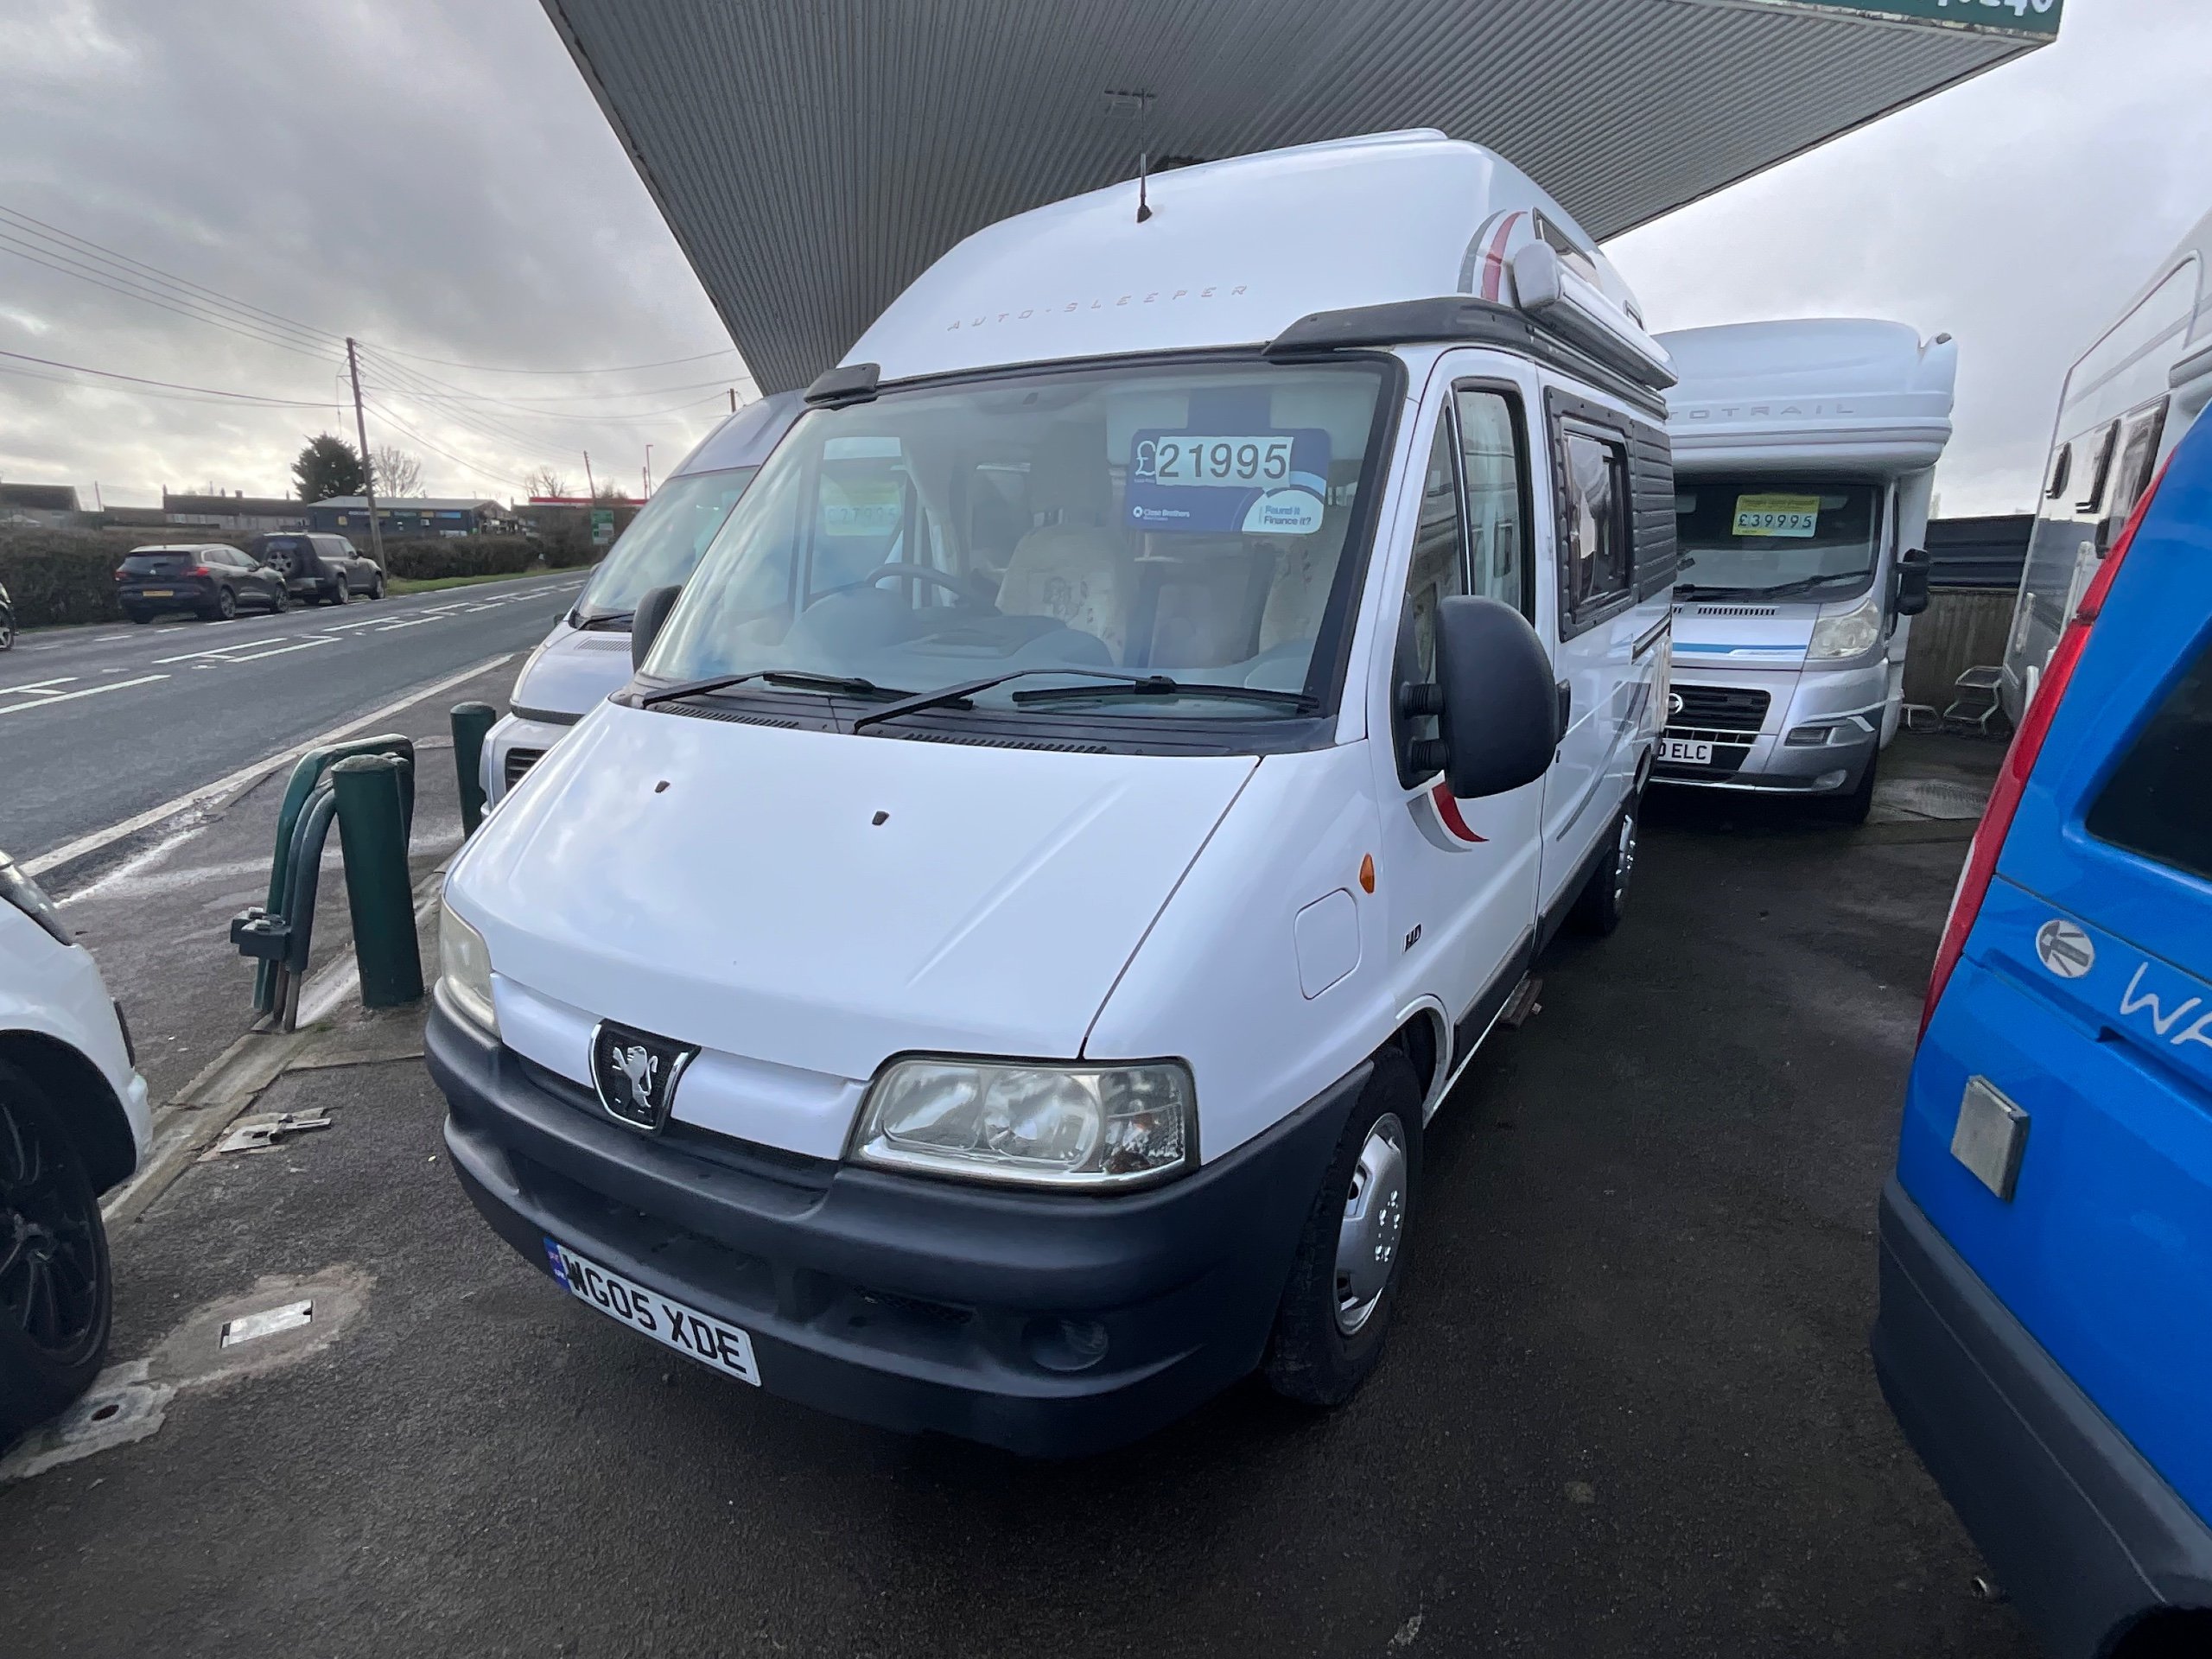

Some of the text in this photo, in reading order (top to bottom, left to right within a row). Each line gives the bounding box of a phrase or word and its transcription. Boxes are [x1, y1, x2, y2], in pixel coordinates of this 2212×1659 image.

[1263, 515, 1299, 525] Finance
[1738, 513, 1812, 529] £39995
[1671, 743, 1707, 760] ELC
[563, 1254, 747, 1375] WG05 XDE
